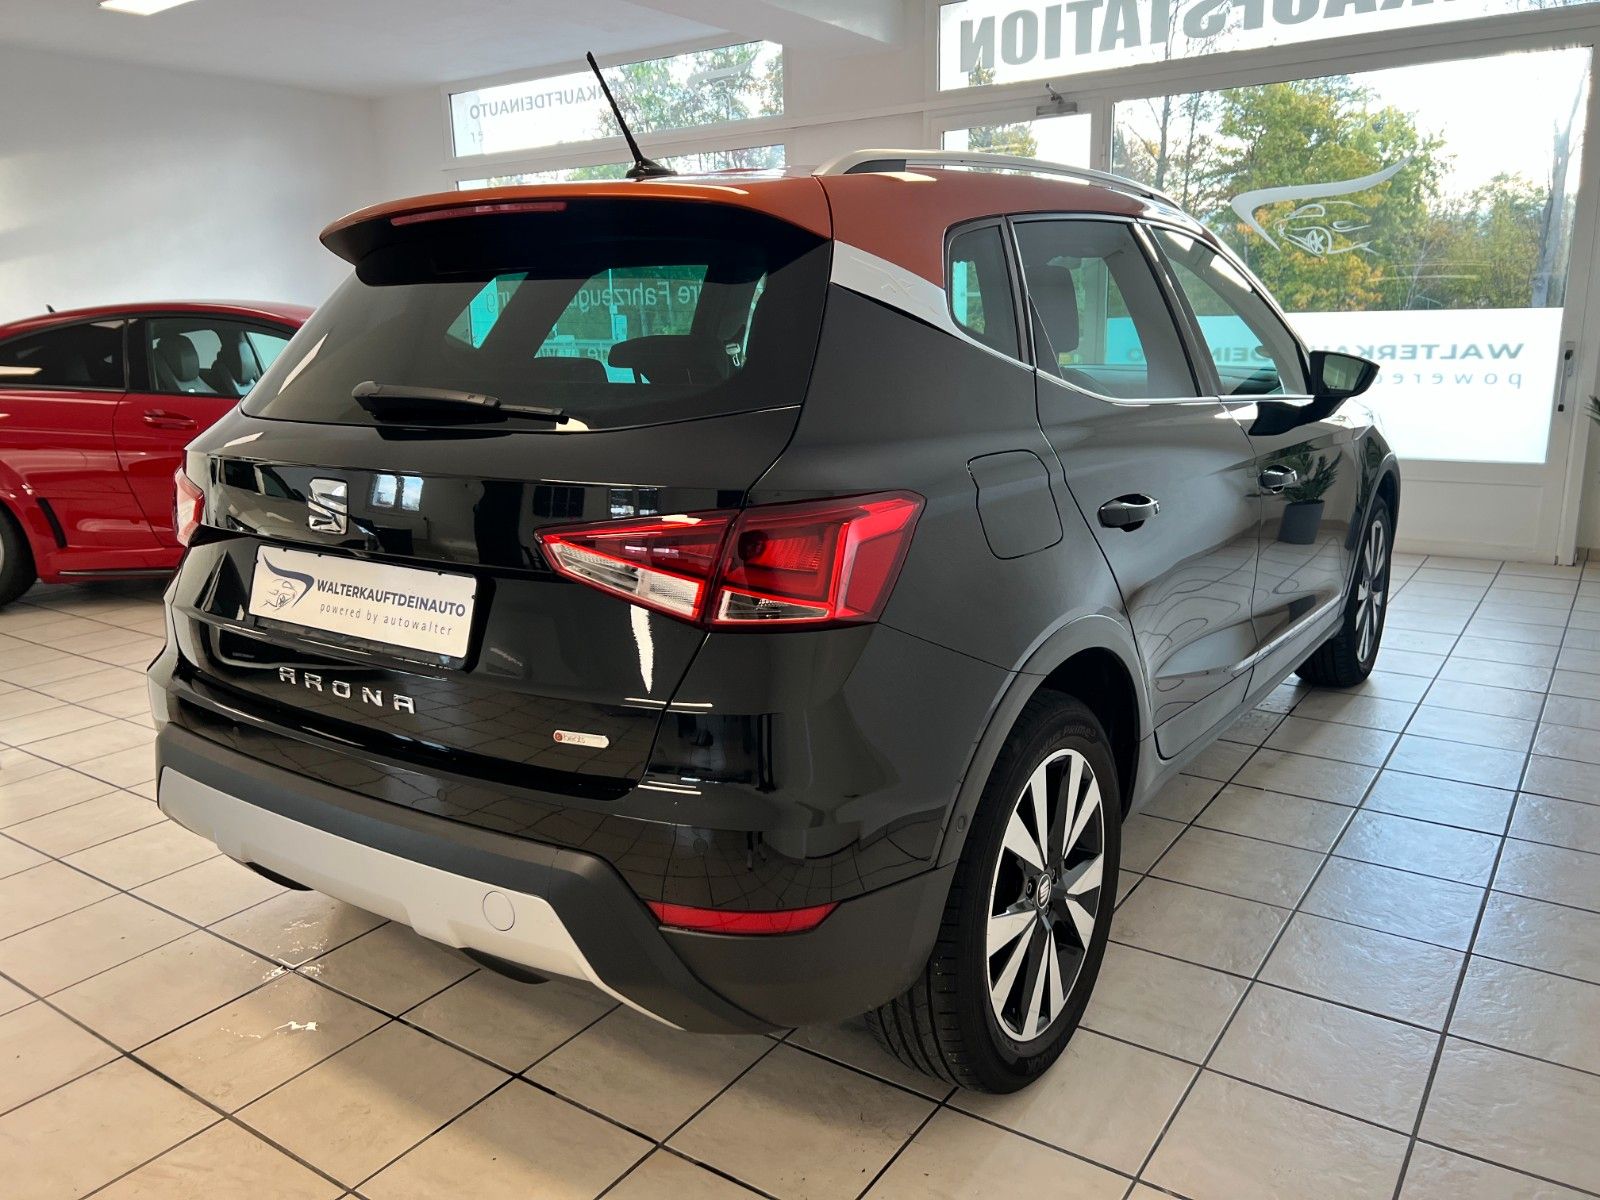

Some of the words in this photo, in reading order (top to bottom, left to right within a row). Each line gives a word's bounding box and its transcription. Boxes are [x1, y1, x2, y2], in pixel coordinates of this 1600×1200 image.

[317, 579, 466, 618] WALTERKAUFTDEINAUTO
[320, 602, 361, 619] powered
[366, 610, 379, 624] by
[383, 614, 453, 636] autowalter
[279, 666, 416, 715] ARONA
